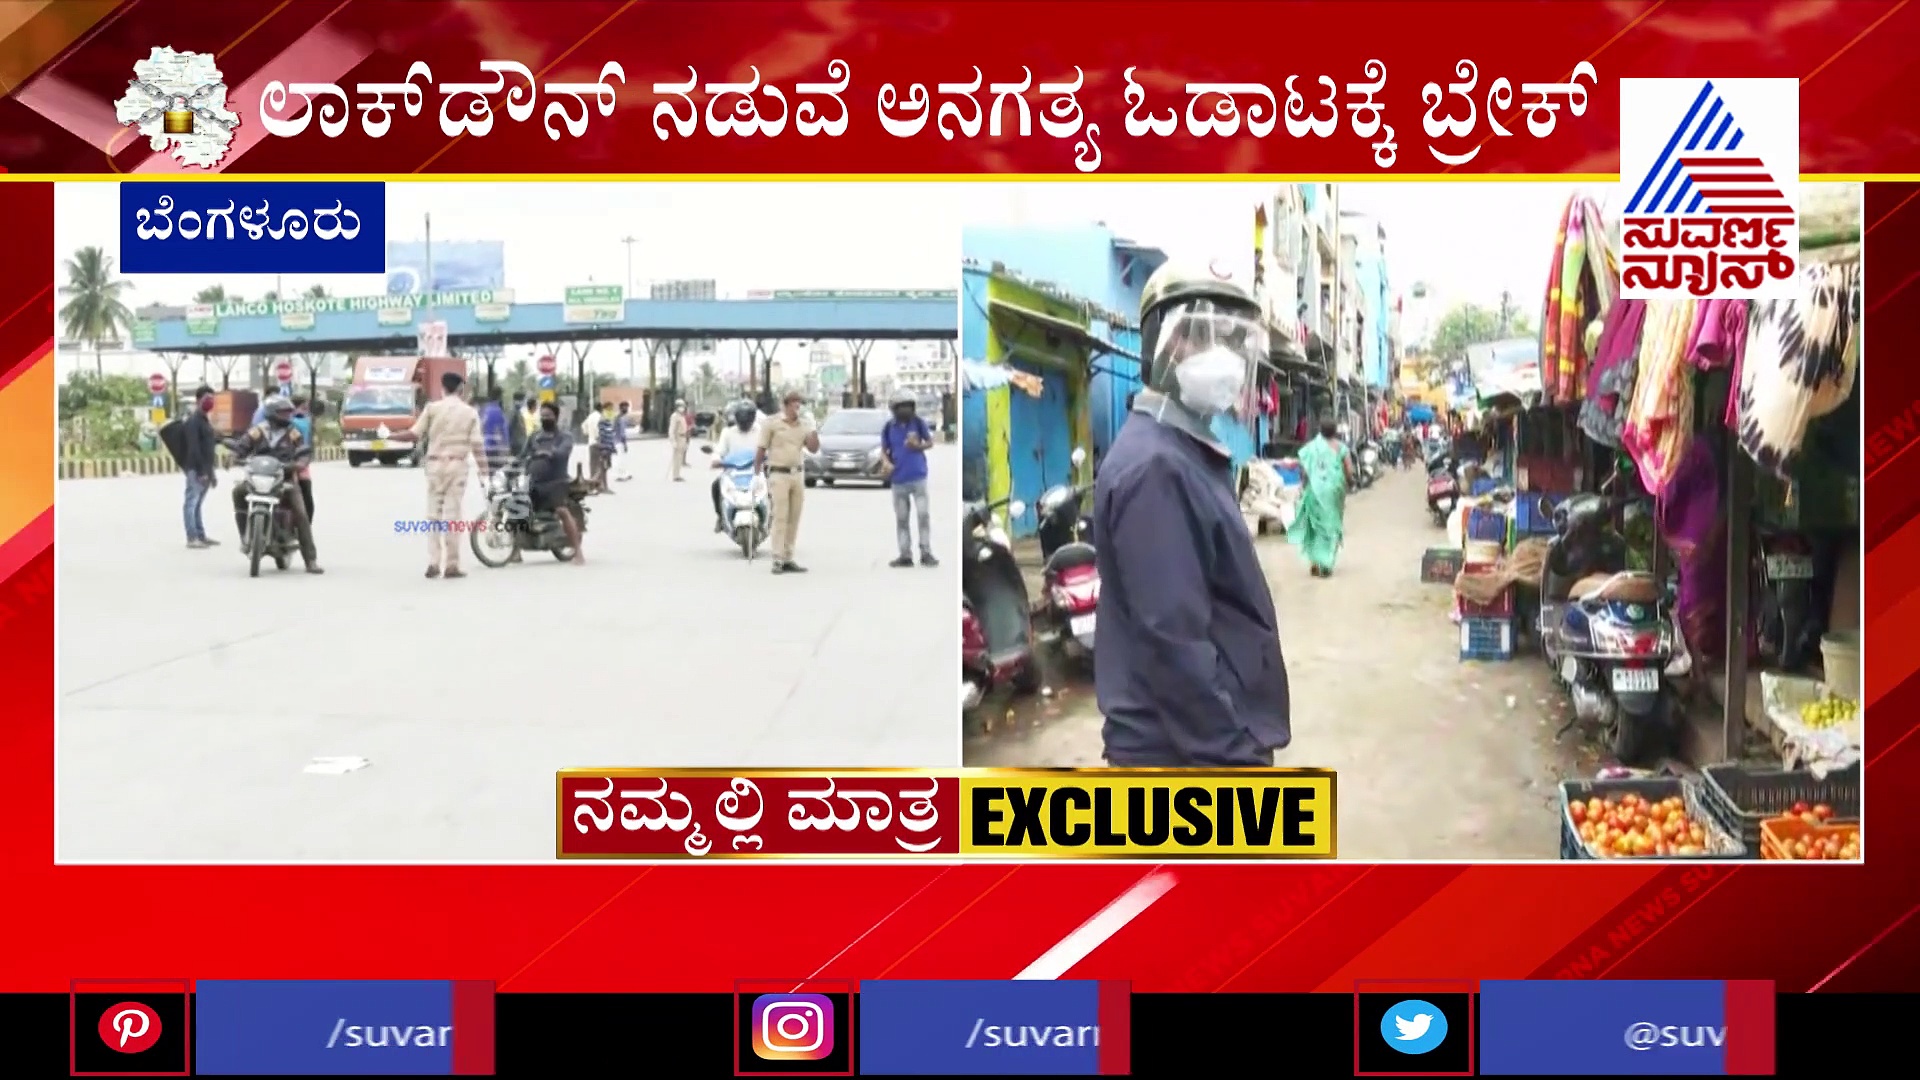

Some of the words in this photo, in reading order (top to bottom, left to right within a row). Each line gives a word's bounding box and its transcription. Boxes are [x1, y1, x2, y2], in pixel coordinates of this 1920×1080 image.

[216, 300, 268, 317] LANCO
[272, 297, 345, 315] HOSKOTE
[351, 293, 422, 310] HIGHWAY
[429, 290, 492, 306] LIMITED
